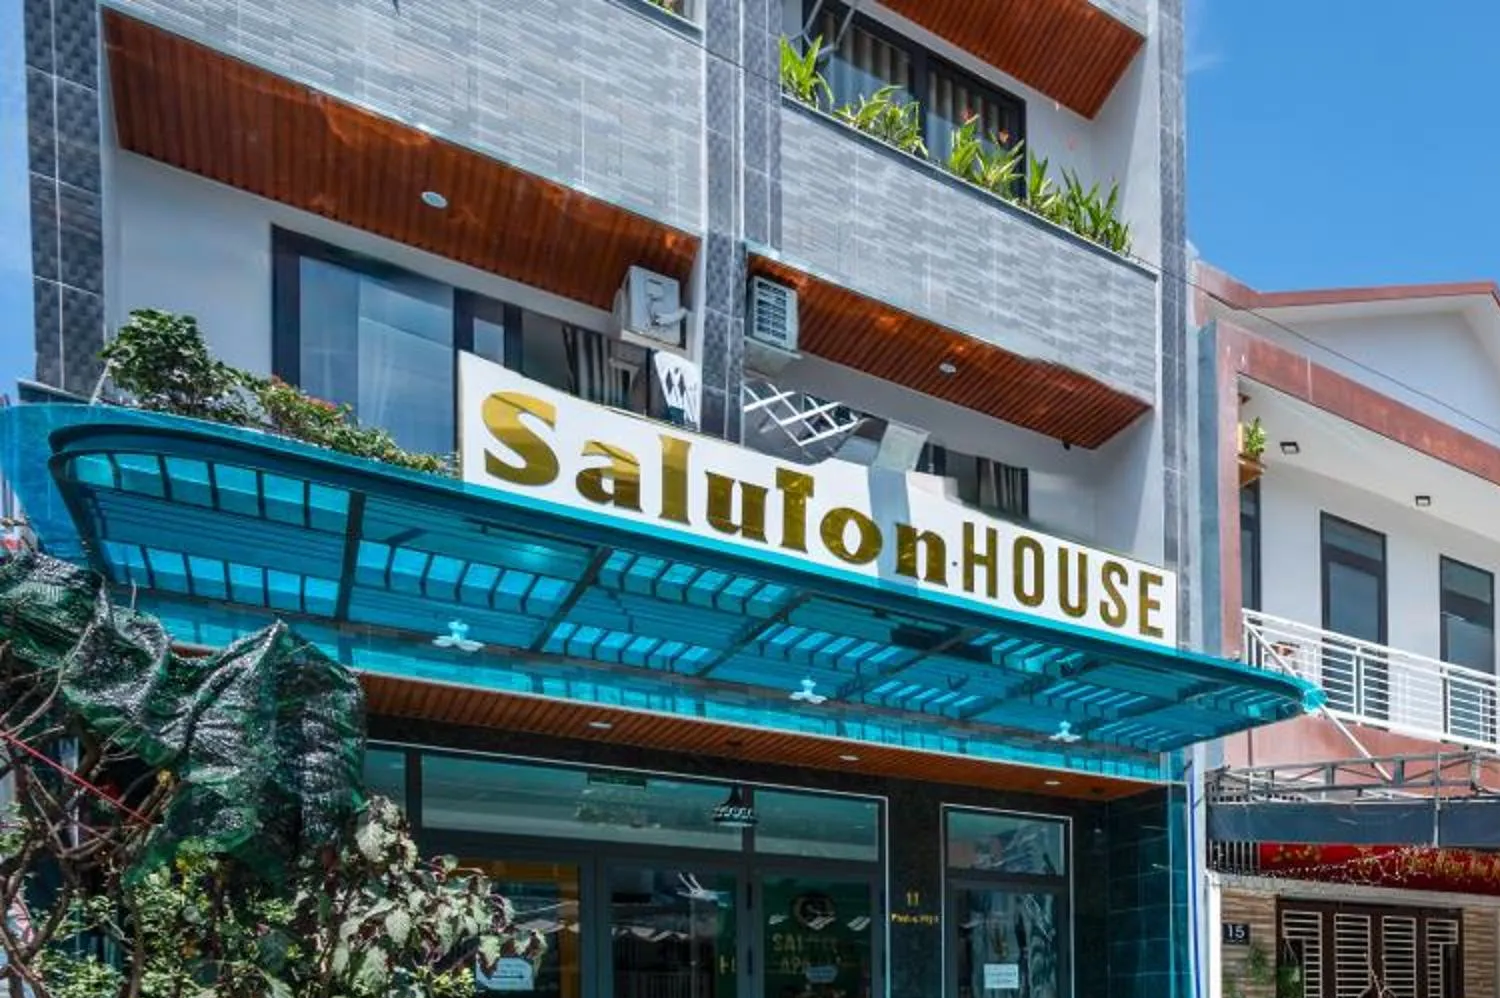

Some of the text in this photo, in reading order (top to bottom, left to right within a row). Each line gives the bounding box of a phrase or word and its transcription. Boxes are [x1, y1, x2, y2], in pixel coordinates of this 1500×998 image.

[482, 391, 1164, 638] Saluton HOUSE
[1227, 923, 1245, 939] 15
